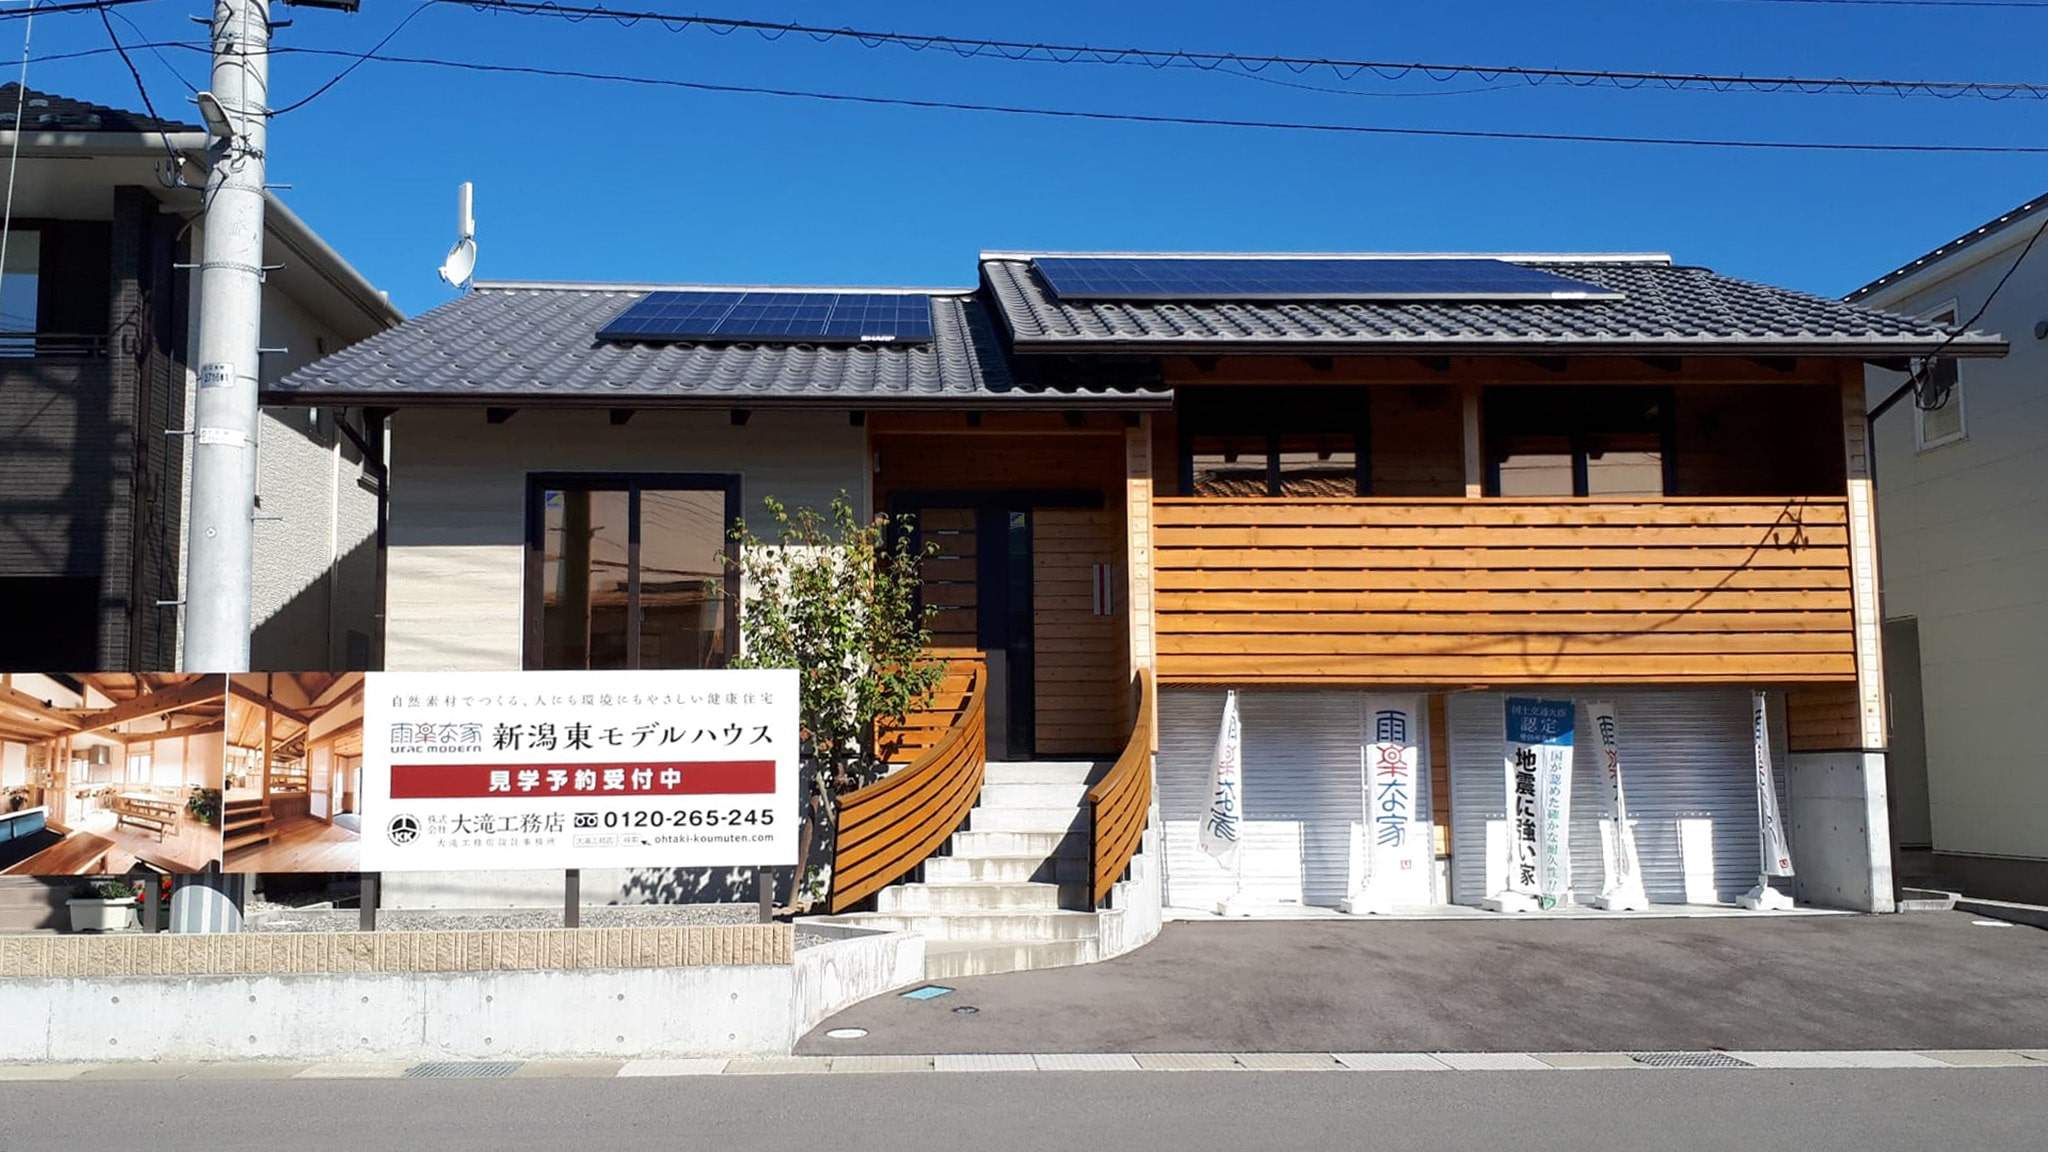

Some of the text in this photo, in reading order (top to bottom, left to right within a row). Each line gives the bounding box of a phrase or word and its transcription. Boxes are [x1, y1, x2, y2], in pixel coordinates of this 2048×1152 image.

[492, 720, 773, 751] 新潟東モデルハウス
[1520, 717, 1558, 734] 認定
[488, 768, 683, 792] 見学予約受付中
[1376, 710, 1408, 847] 雨楽な家
[451, 811, 566, 834] 大滝工務店
[603, 809, 775, 828] 0120-265-245
[1515, 747, 1537, 886] 地震に強い家
[654, 833, 774, 844] ohtaki-koumuten.com
